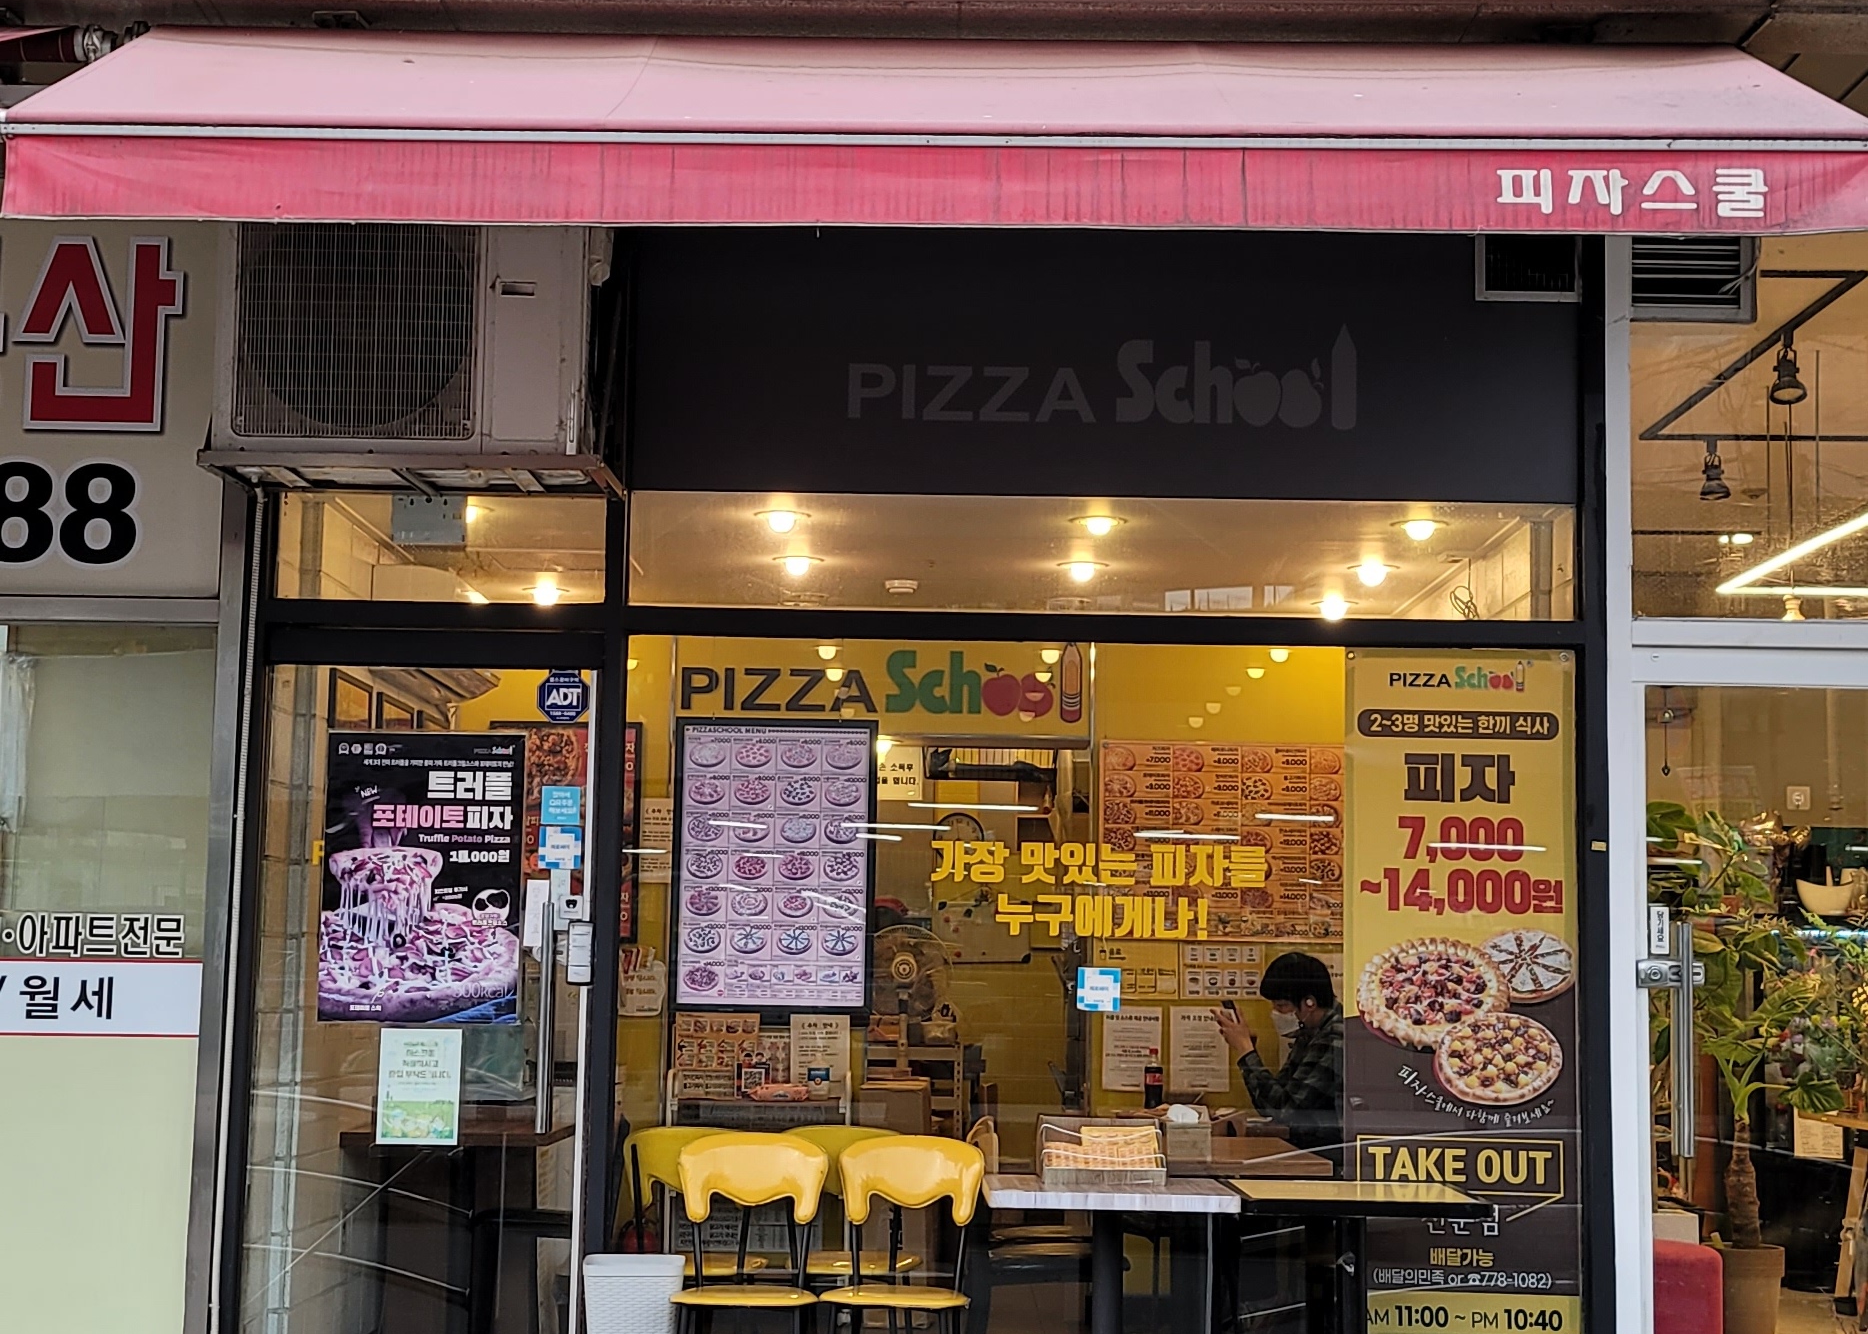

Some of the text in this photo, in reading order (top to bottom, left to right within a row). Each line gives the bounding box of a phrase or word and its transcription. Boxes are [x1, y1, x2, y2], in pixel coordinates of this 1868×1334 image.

[1496, 168, 1768, 218] 피자스쿨
[847, 323, 1357, 431] PIZZA School
[546, 687, 581, 706] ADT
[680, 642, 1082, 723] PIZZA School
[1388, 672, 1452, 688] PIZZA
[1369, 713, 1550, 735] 2~3명 맛있는 한끼 식사
[360, 785, 378, 798] NEW
[427, 771, 512, 800] 트러플
[1404, 753, 1516, 804] 피자
[418, 834, 511, 844] Truffle Potato Pizza
[1398, 816, 1524, 863] 7,000
[930, 841, 1268, 888] 가장 맛있는 피자를
[1360, 867, 1564, 916] ~14,000원
[996, 894, 1209, 940] 누구에게나!
[1398, 1065, 1464, 1117] 피자스쿨에서
[1368, 1146, 1552, 1185] TAKE OUT
[1429, 1247, 1495, 1267] 배달가능
[1373, 1269, 1445, 1285] (배달의민족
[1448, 1274, 1466, 1285] or
[1394, 1305, 1449, 1328] 11:00
[1471, 1312, 1499, 1329] PM
[1503, 1309, 1563, 1332] 10:40
